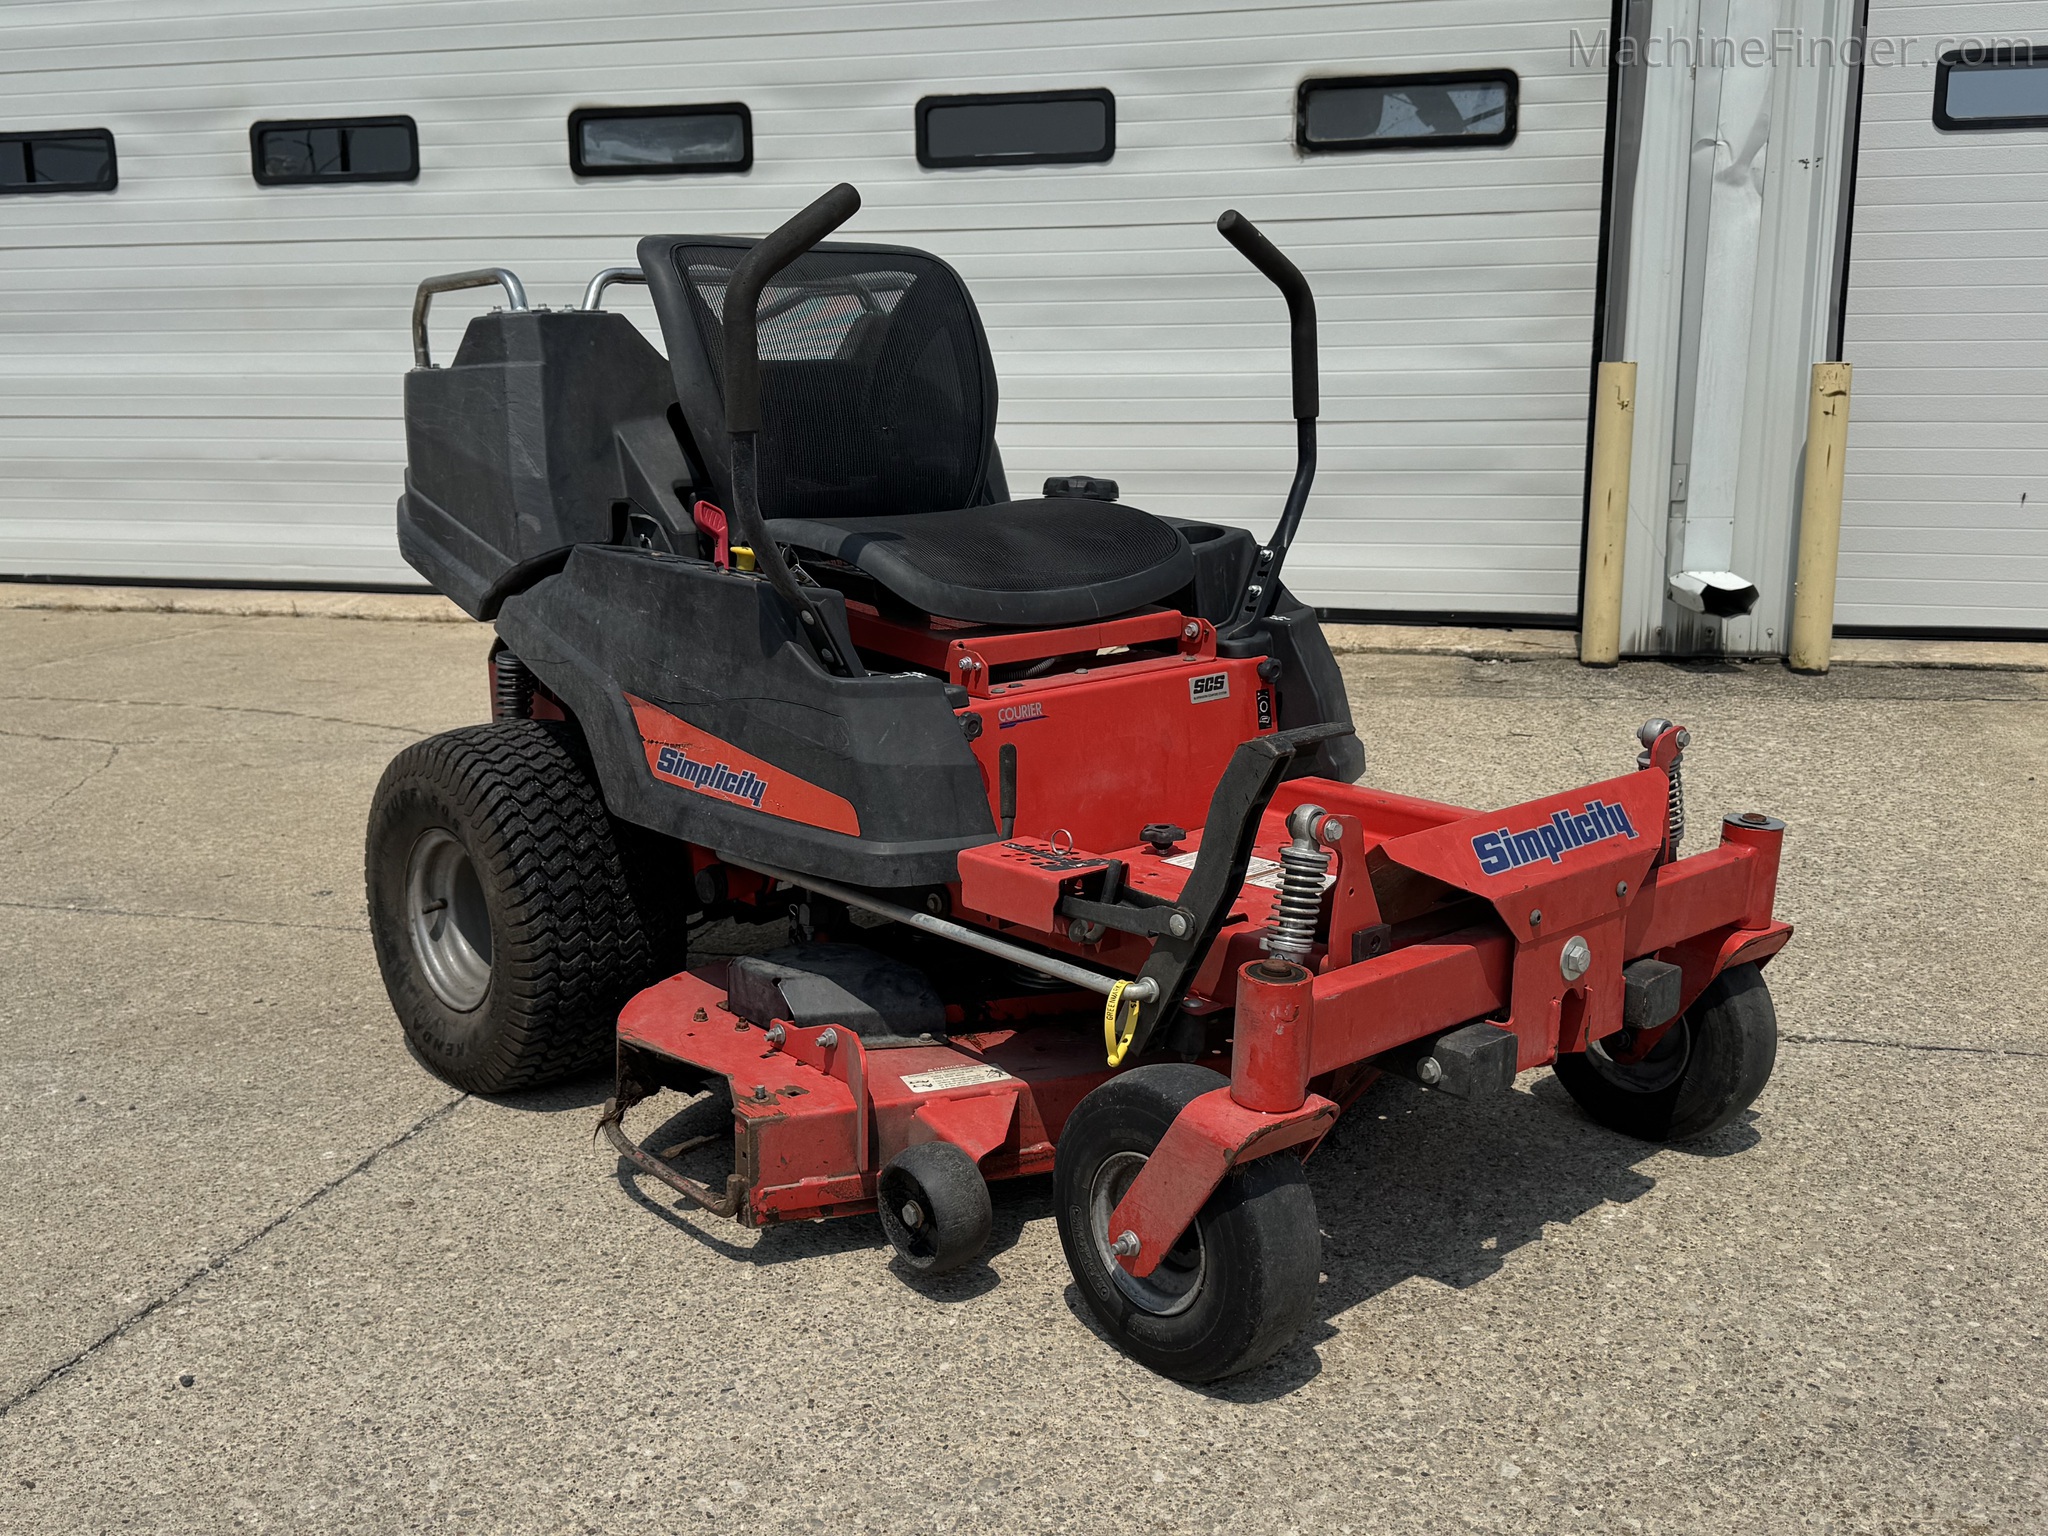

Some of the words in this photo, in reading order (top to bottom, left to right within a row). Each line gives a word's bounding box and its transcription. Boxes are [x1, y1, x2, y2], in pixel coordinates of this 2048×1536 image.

[1193, 674, 1226, 695] SCS
[998, 702, 1043, 722] COURIER
[656, 746, 767, 808] Simplicity
[1471, 800, 1639, 876] Simplicity
[413, 1017, 465, 1058] KENDA
